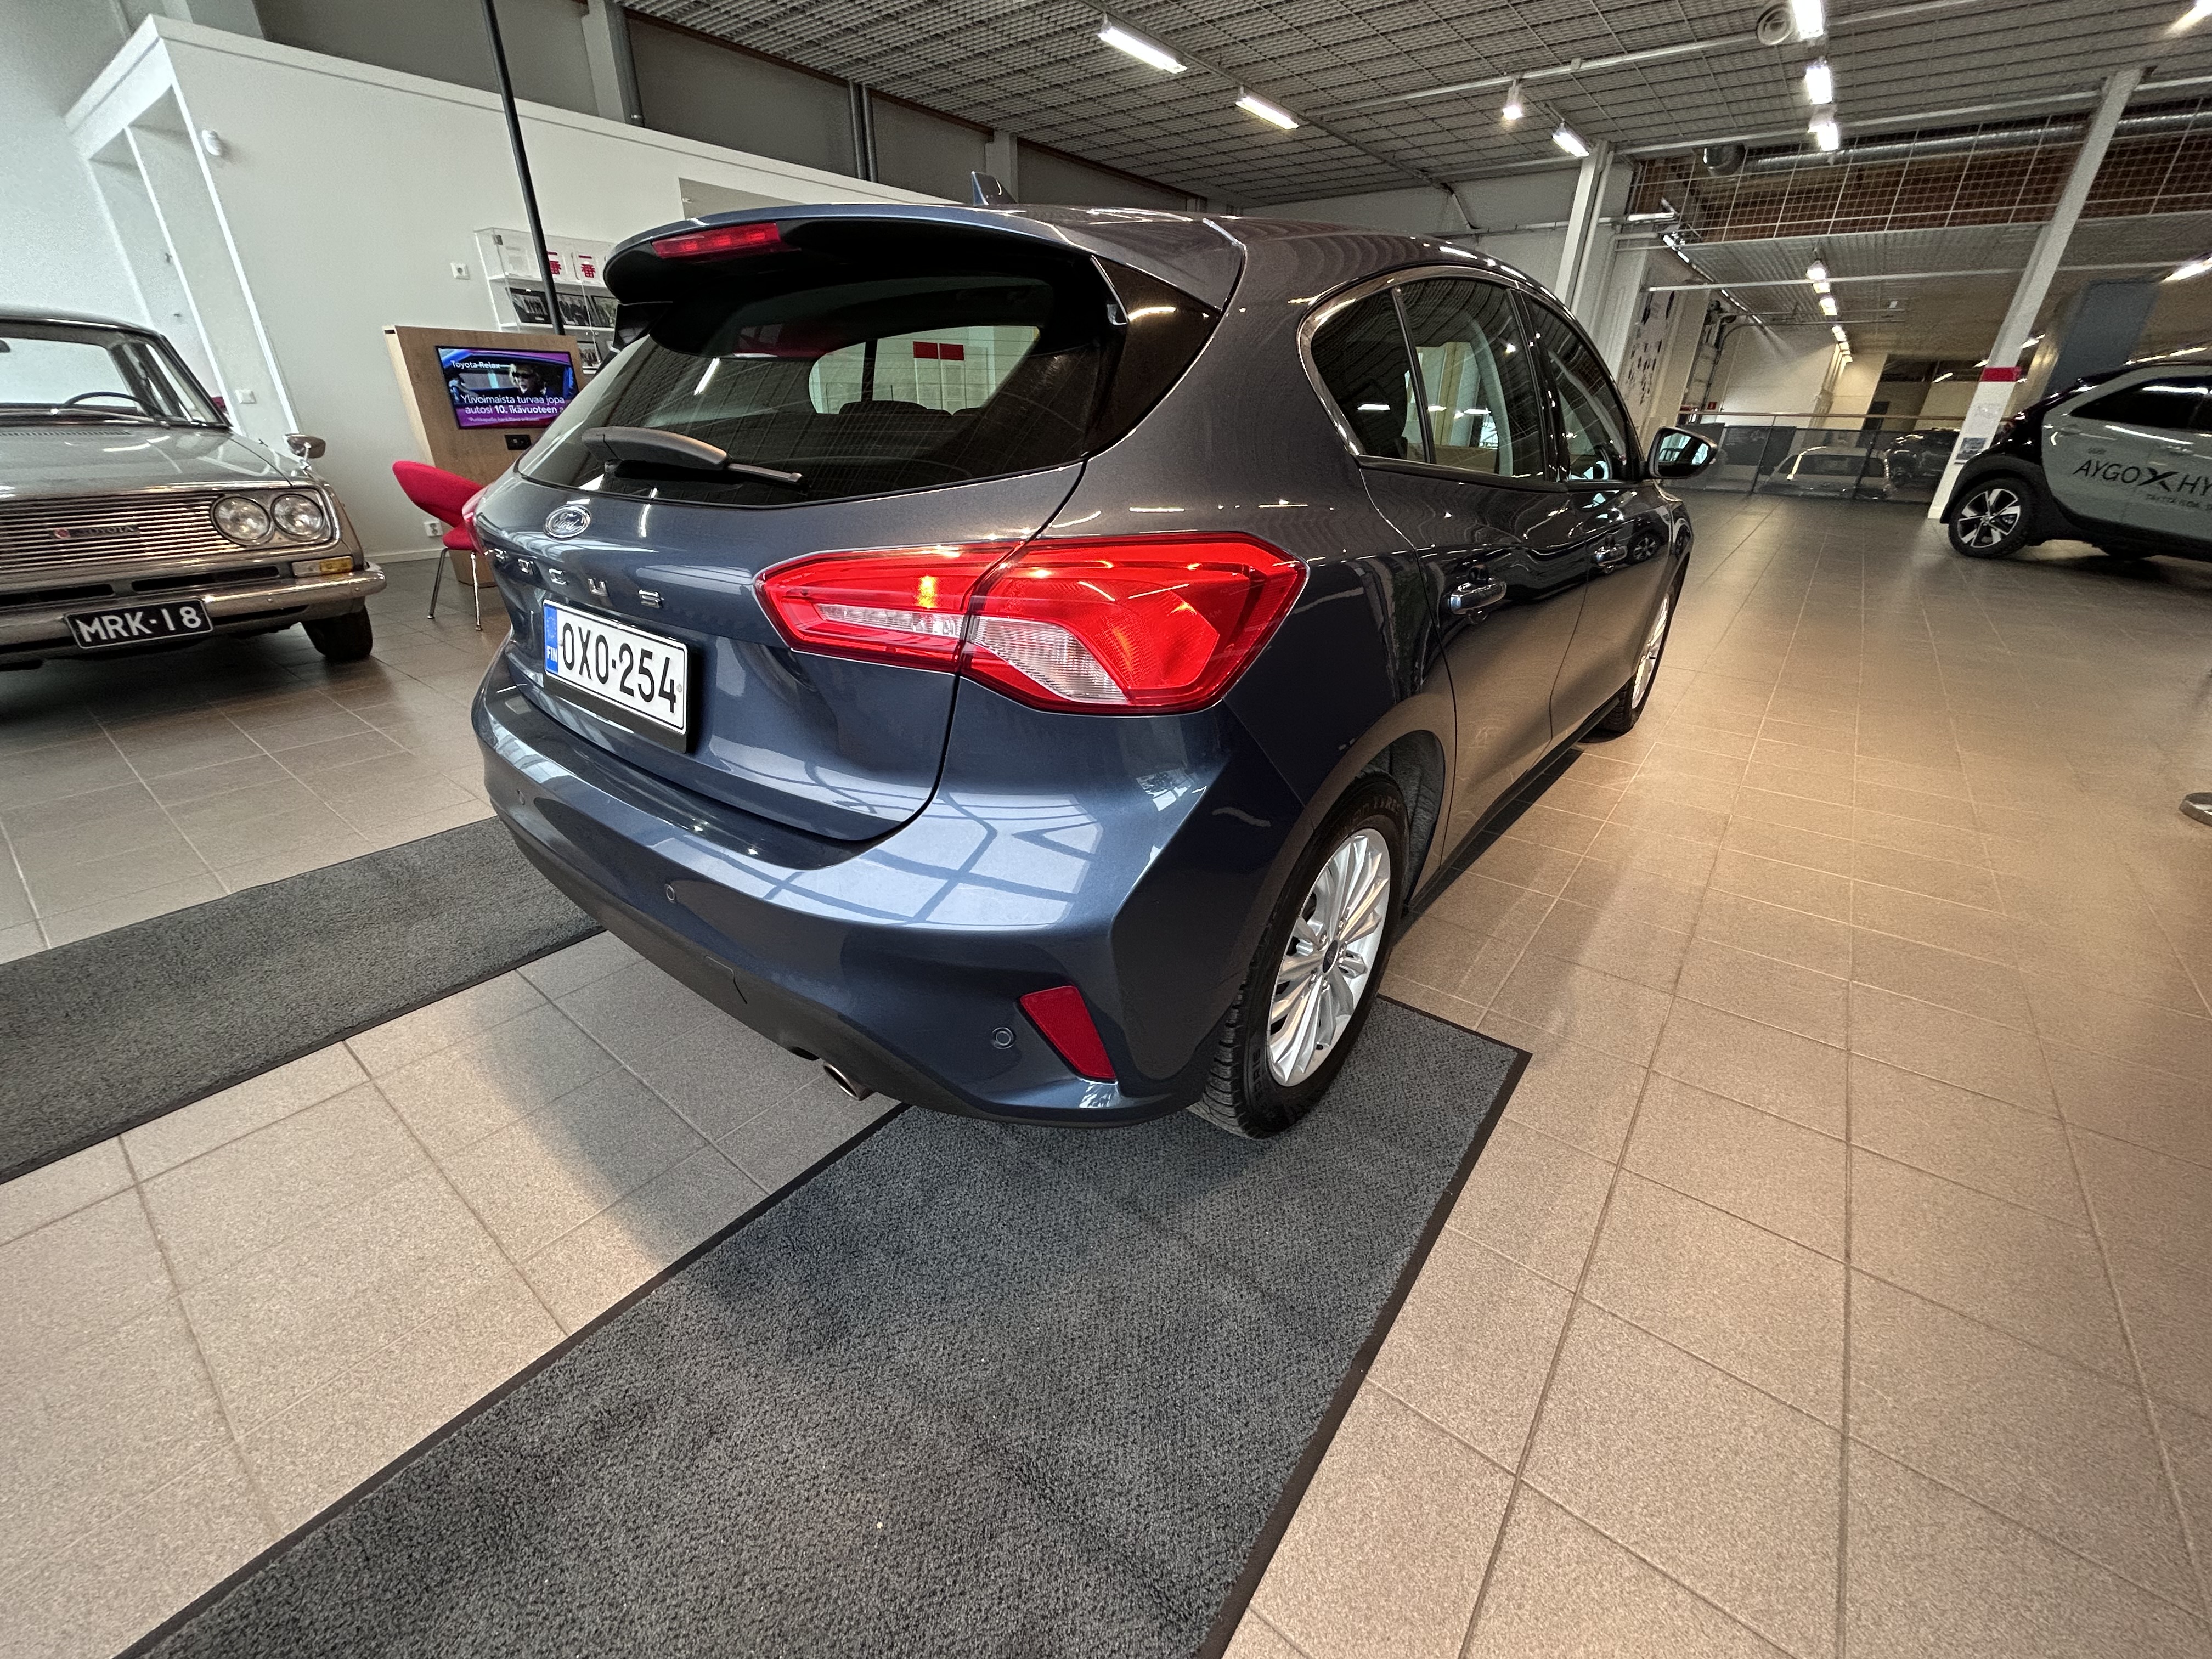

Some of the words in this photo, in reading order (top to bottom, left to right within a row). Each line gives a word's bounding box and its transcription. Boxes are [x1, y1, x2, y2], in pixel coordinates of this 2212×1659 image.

[451, 360, 477, 369] Toyota
[461, 395, 516, 404] Ylivoimaista
[546, 395, 565, 405] jopa
[465, 405, 493, 414] autosi
[509, 405, 557, 414] ikävuoteen
[2073, 459, 2141, 483] AYGO
[553, 512, 583, 531] Ford
[77, 606, 201, 643] MRK-18
[546, 645, 558, 663] FIN
[562, 623, 676, 713] OXO-254
